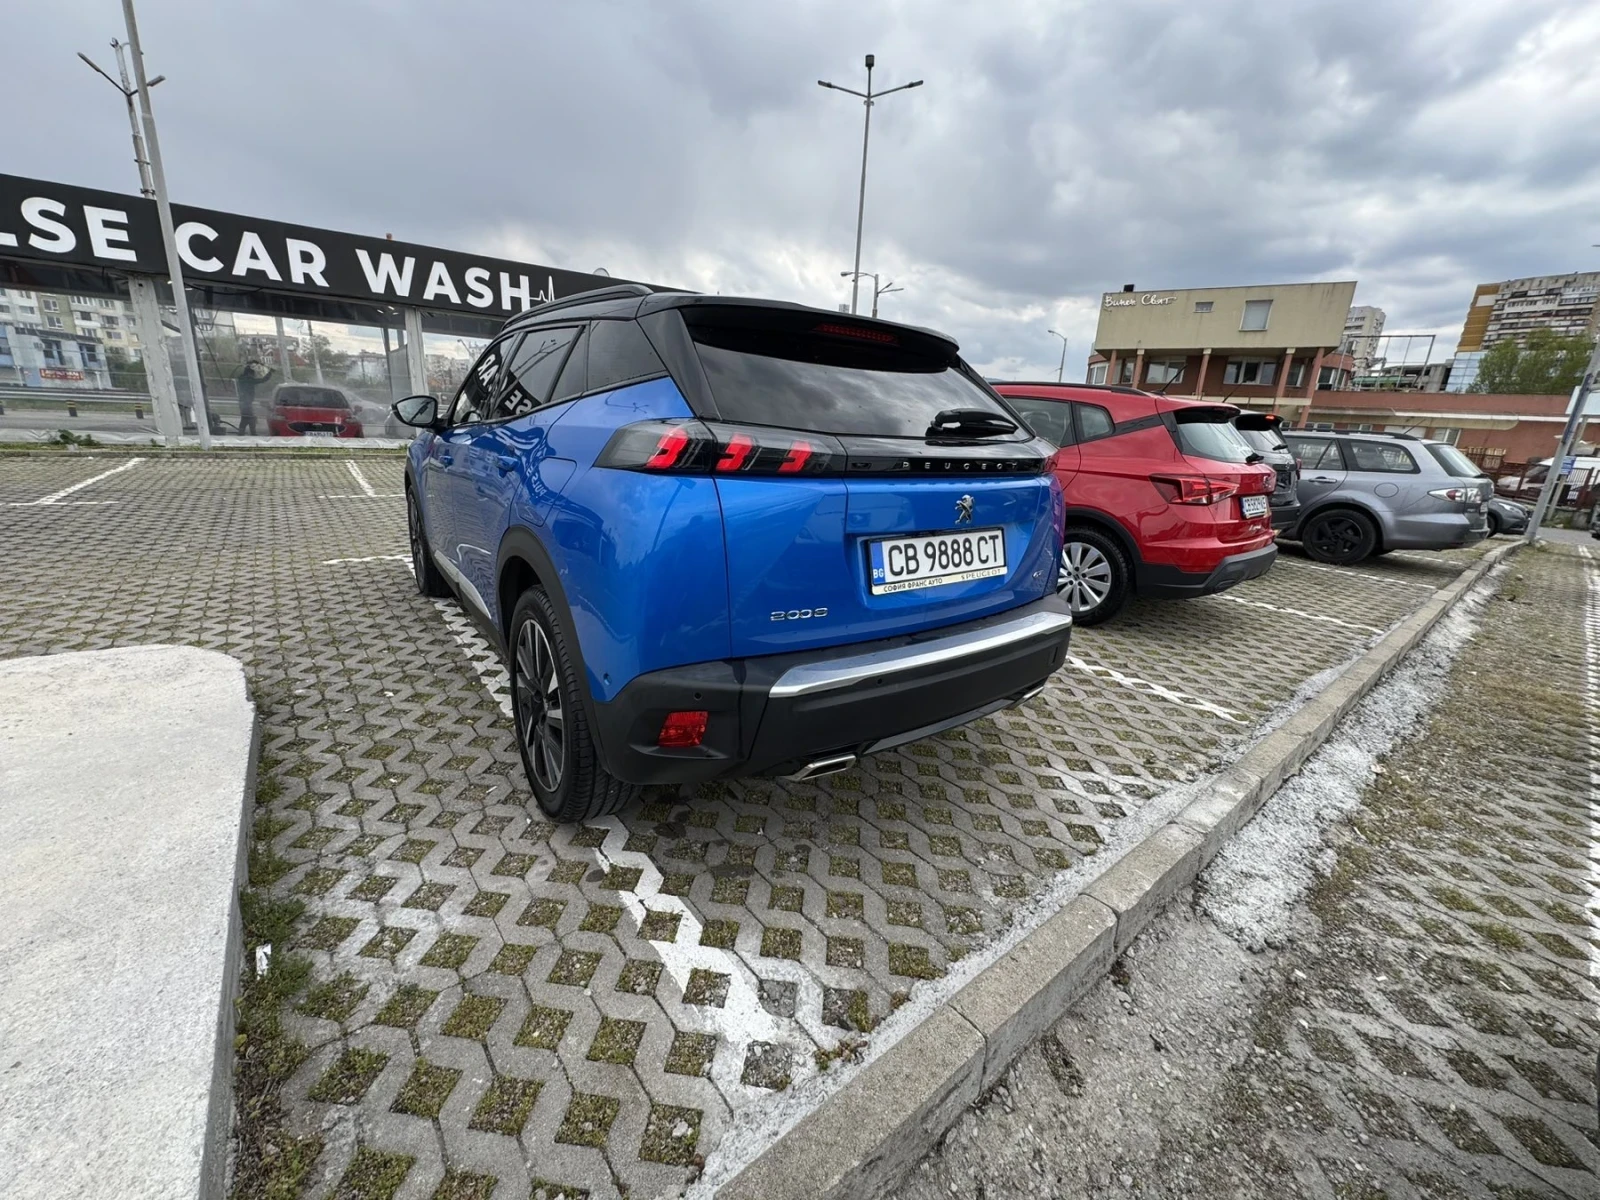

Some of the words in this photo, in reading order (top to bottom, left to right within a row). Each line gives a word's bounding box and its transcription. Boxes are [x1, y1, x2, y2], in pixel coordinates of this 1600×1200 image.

[174, 221, 330, 287] CAR
[355, 248, 531, 312] WASH
[902, 461, 1018, 470] PEUGEOT
[888, 543, 920, 577] CB
[926, 537, 975, 570] 9888
[977, 534, 1000, 565] CT
[873, 568, 884, 578] BG
[883, 584, 906, 593] СОФИЯ
[907, 580, 928, 589] ФРАНС
[928, 578, 943, 586] АУТО
[770, 607, 828, 621] 2008
